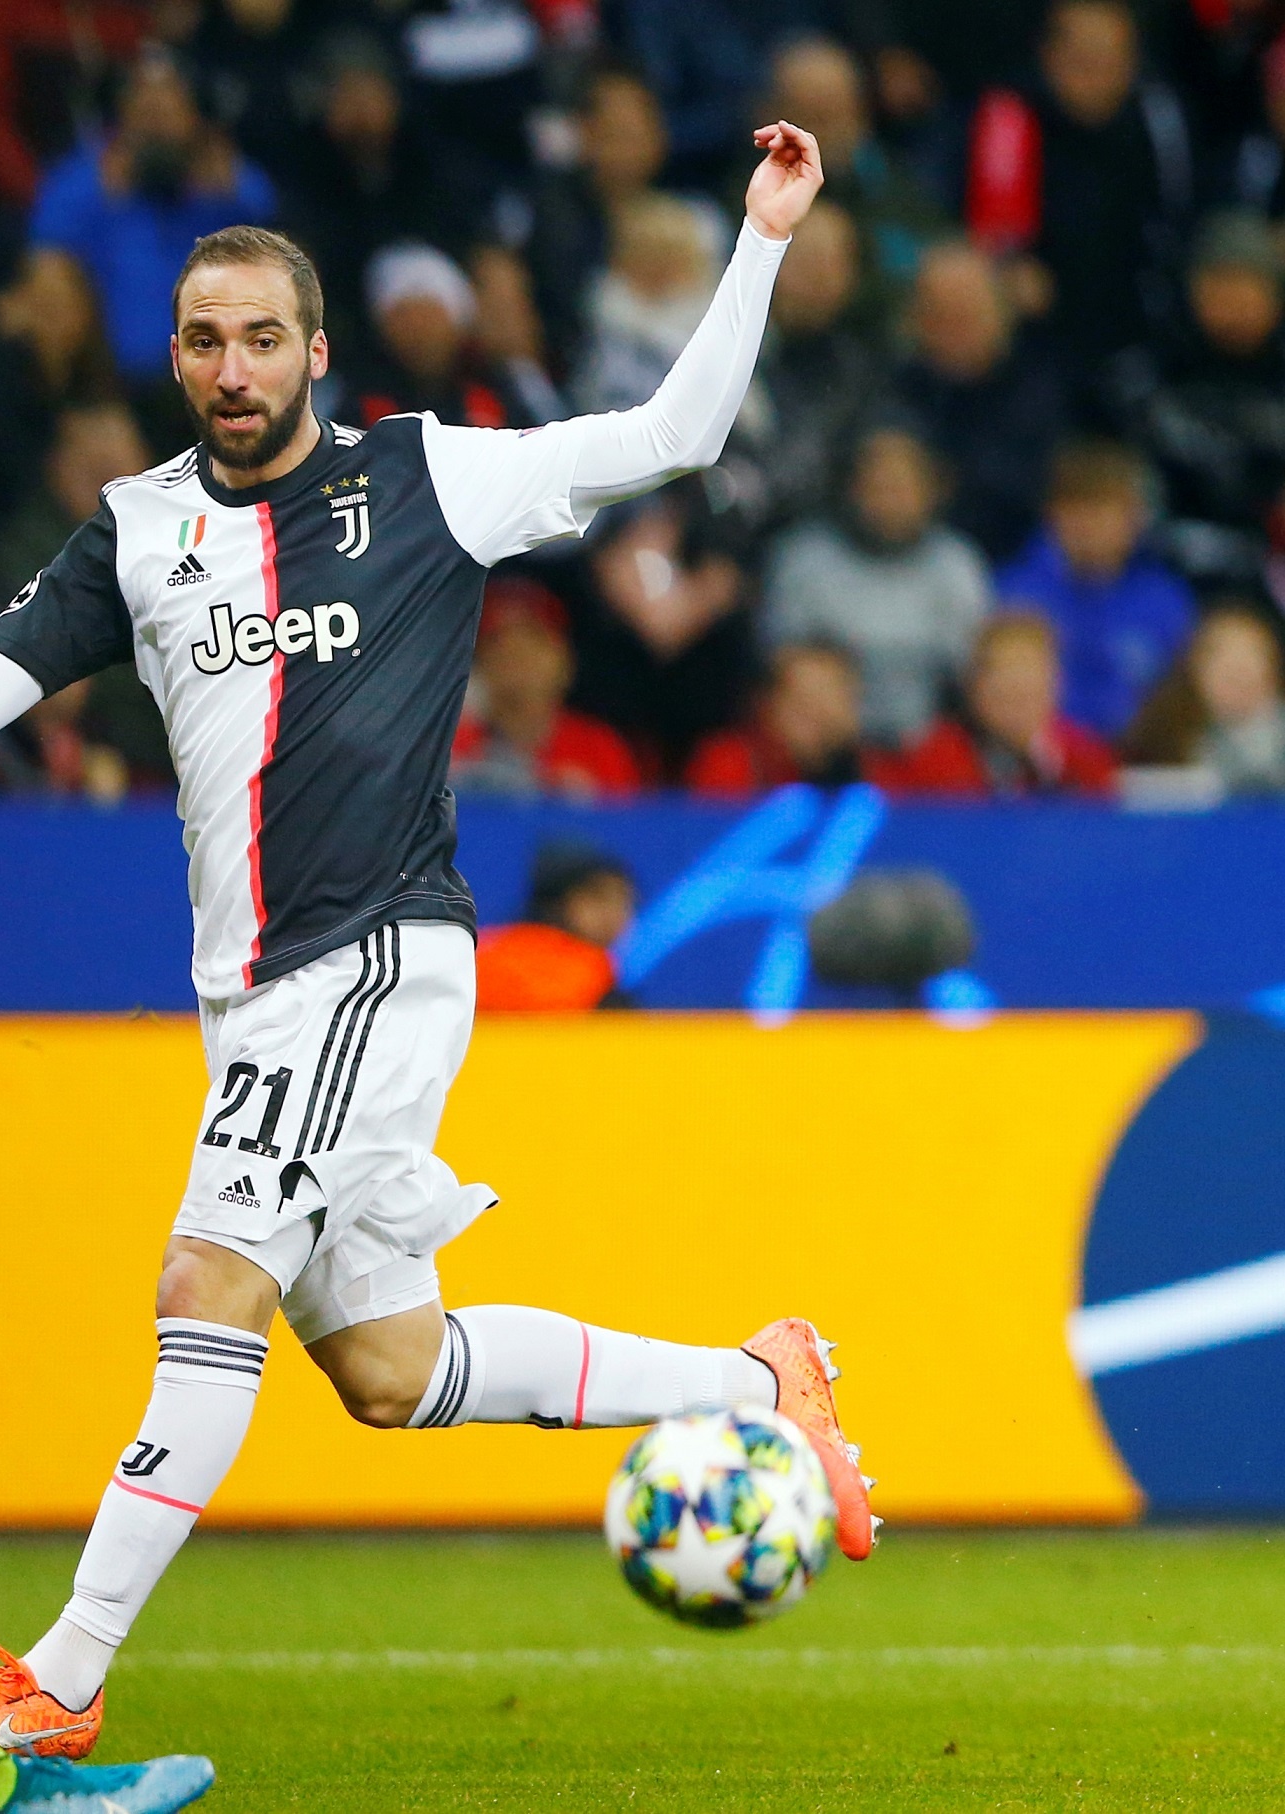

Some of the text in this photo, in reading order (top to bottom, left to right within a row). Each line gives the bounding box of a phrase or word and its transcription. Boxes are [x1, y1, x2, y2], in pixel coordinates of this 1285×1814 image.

[166, 571, 212, 587] adidas
[191, 601, 360, 675] Jeep
[200, 1062, 293, 1159] 21
[218, 1190, 261, 1209] adidas
